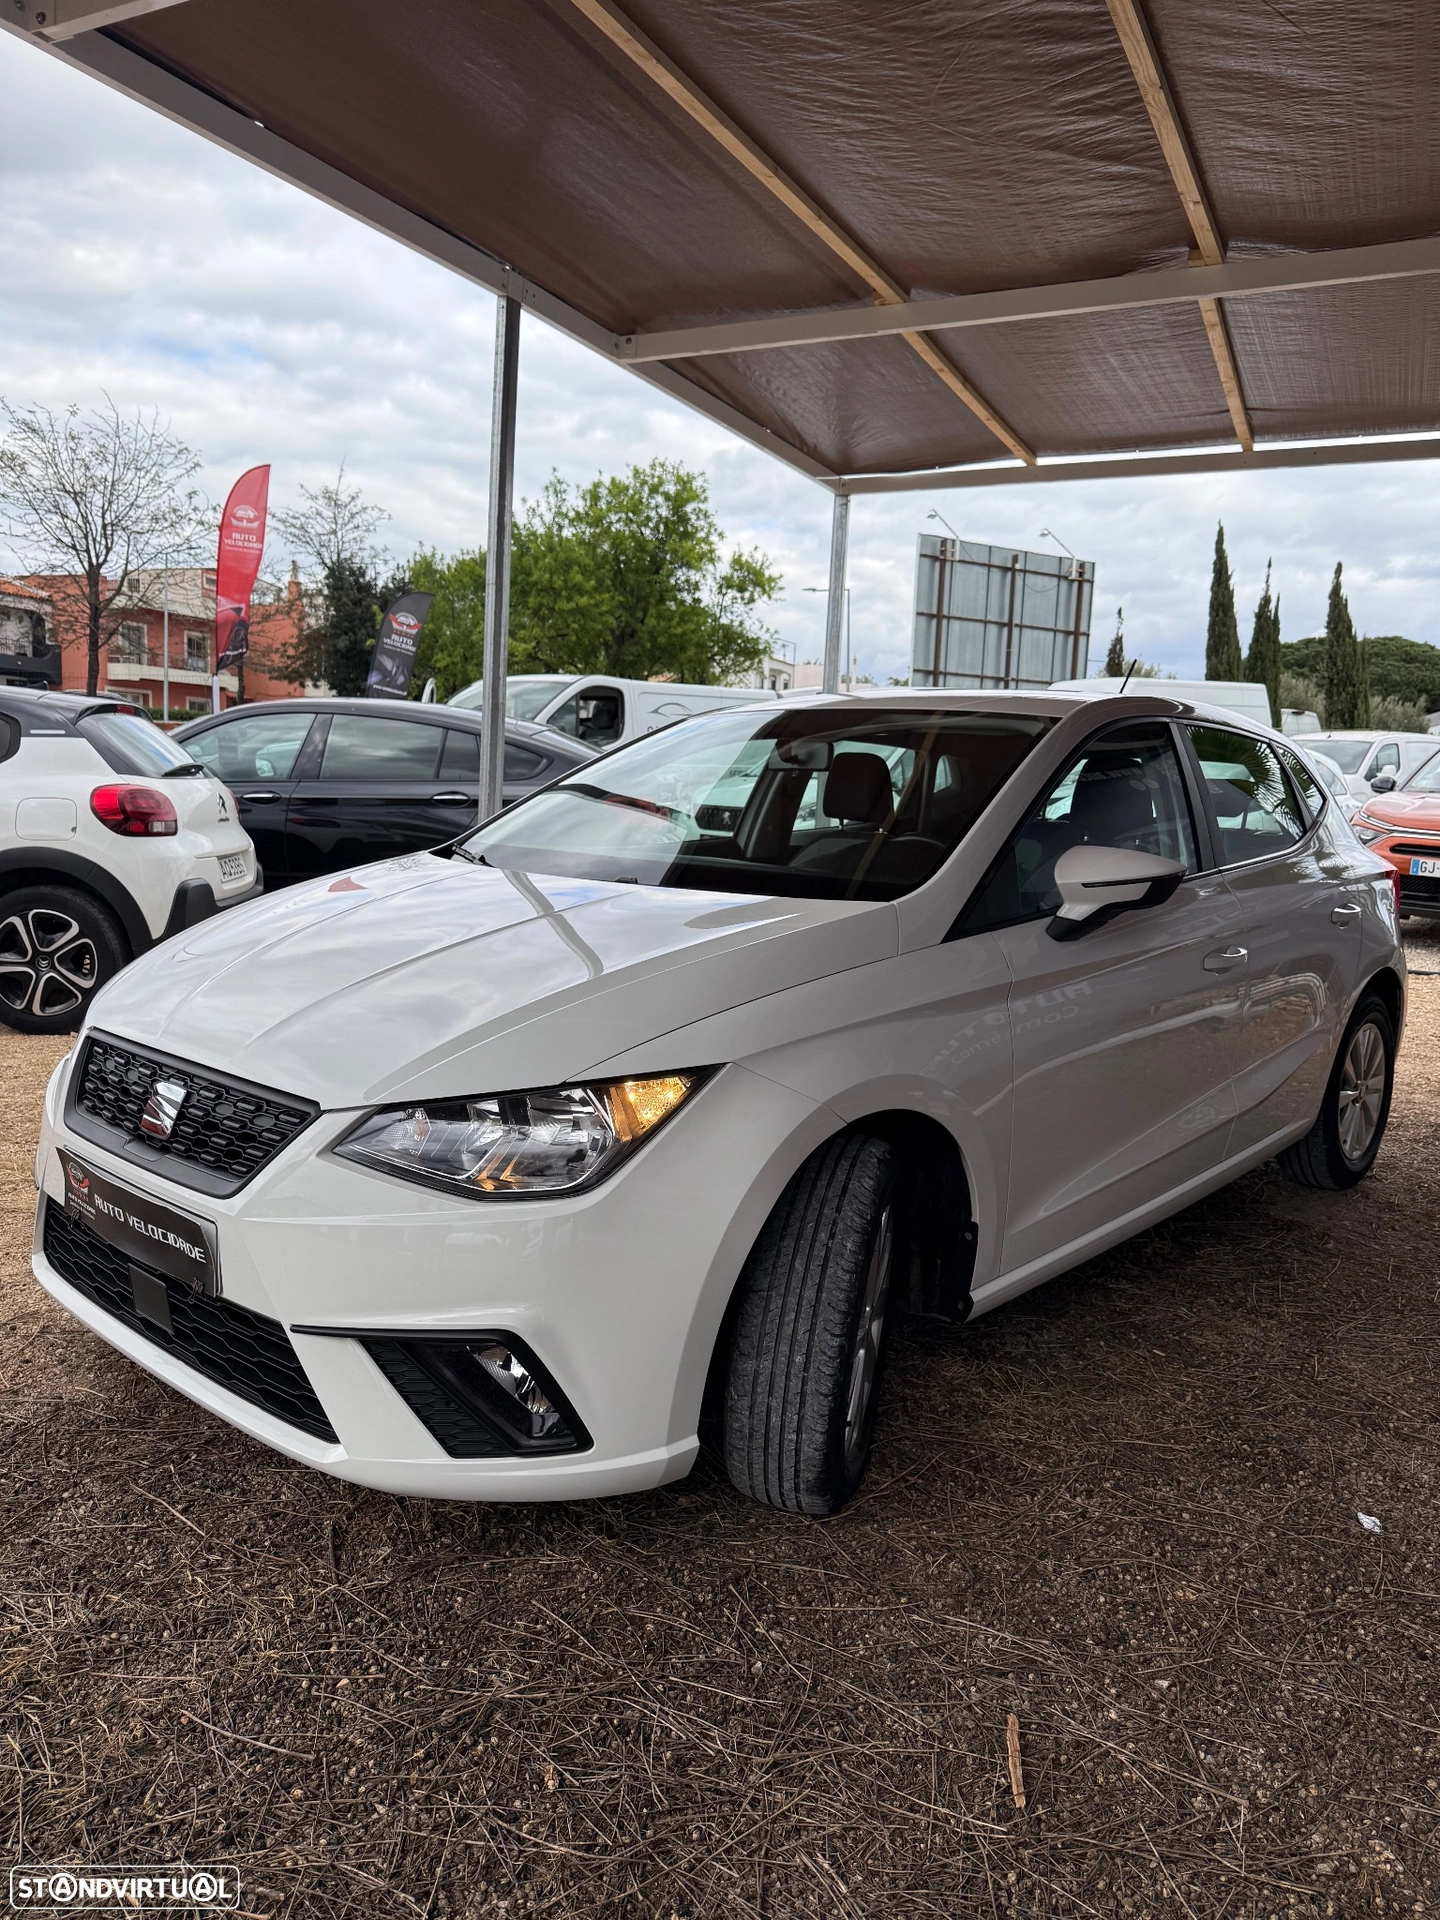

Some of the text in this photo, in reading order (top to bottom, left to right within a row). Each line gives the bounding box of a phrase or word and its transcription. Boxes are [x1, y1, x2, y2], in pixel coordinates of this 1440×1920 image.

[232, 532, 257, 542] AUTO
[391, 633, 413, 646] AUTO
[94, 1193, 125, 1223] AUTO
[125, 1212, 207, 1264] VELOCIDADE
